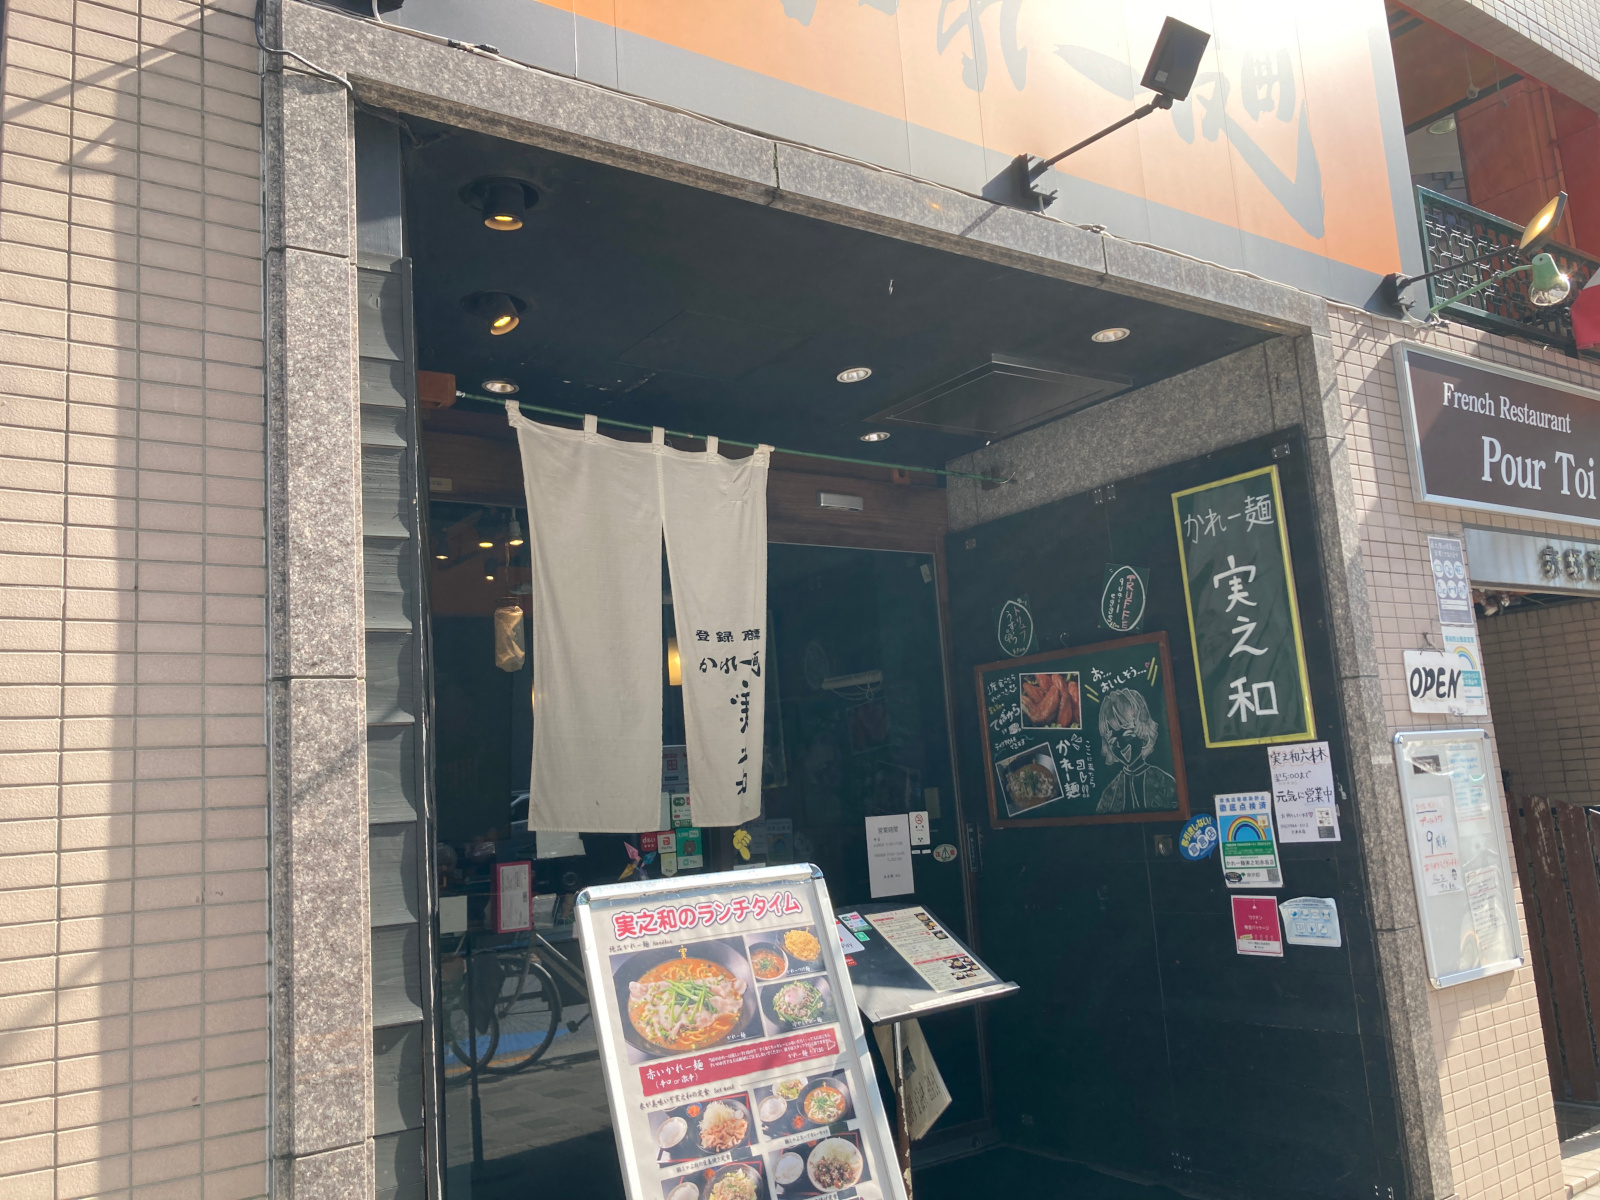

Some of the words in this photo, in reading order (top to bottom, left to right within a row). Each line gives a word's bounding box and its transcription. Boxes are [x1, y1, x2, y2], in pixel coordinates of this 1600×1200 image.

[1442, 381, 1496, 417] French
[1499, 395, 1572, 434] Restaurant
[1481, 435, 1546, 491] Pour
[1555, 451, 1597, 500] Toi
[1184, 494, 1275, 544] かれー麺
[1121, 574, 1136, 629] TRUFFE
[1213, 555, 1279, 723] 実之和
[1409, 666, 1462, 699] OPEN
[1055, 739, 1081, 800] かれー麺
[1276, 786, 1333, 803] 元気に営業中
[613, 891, 803, 940] 実之和のランチタイム
[646, 1058, 704, 1081] 赤いかれー麺
